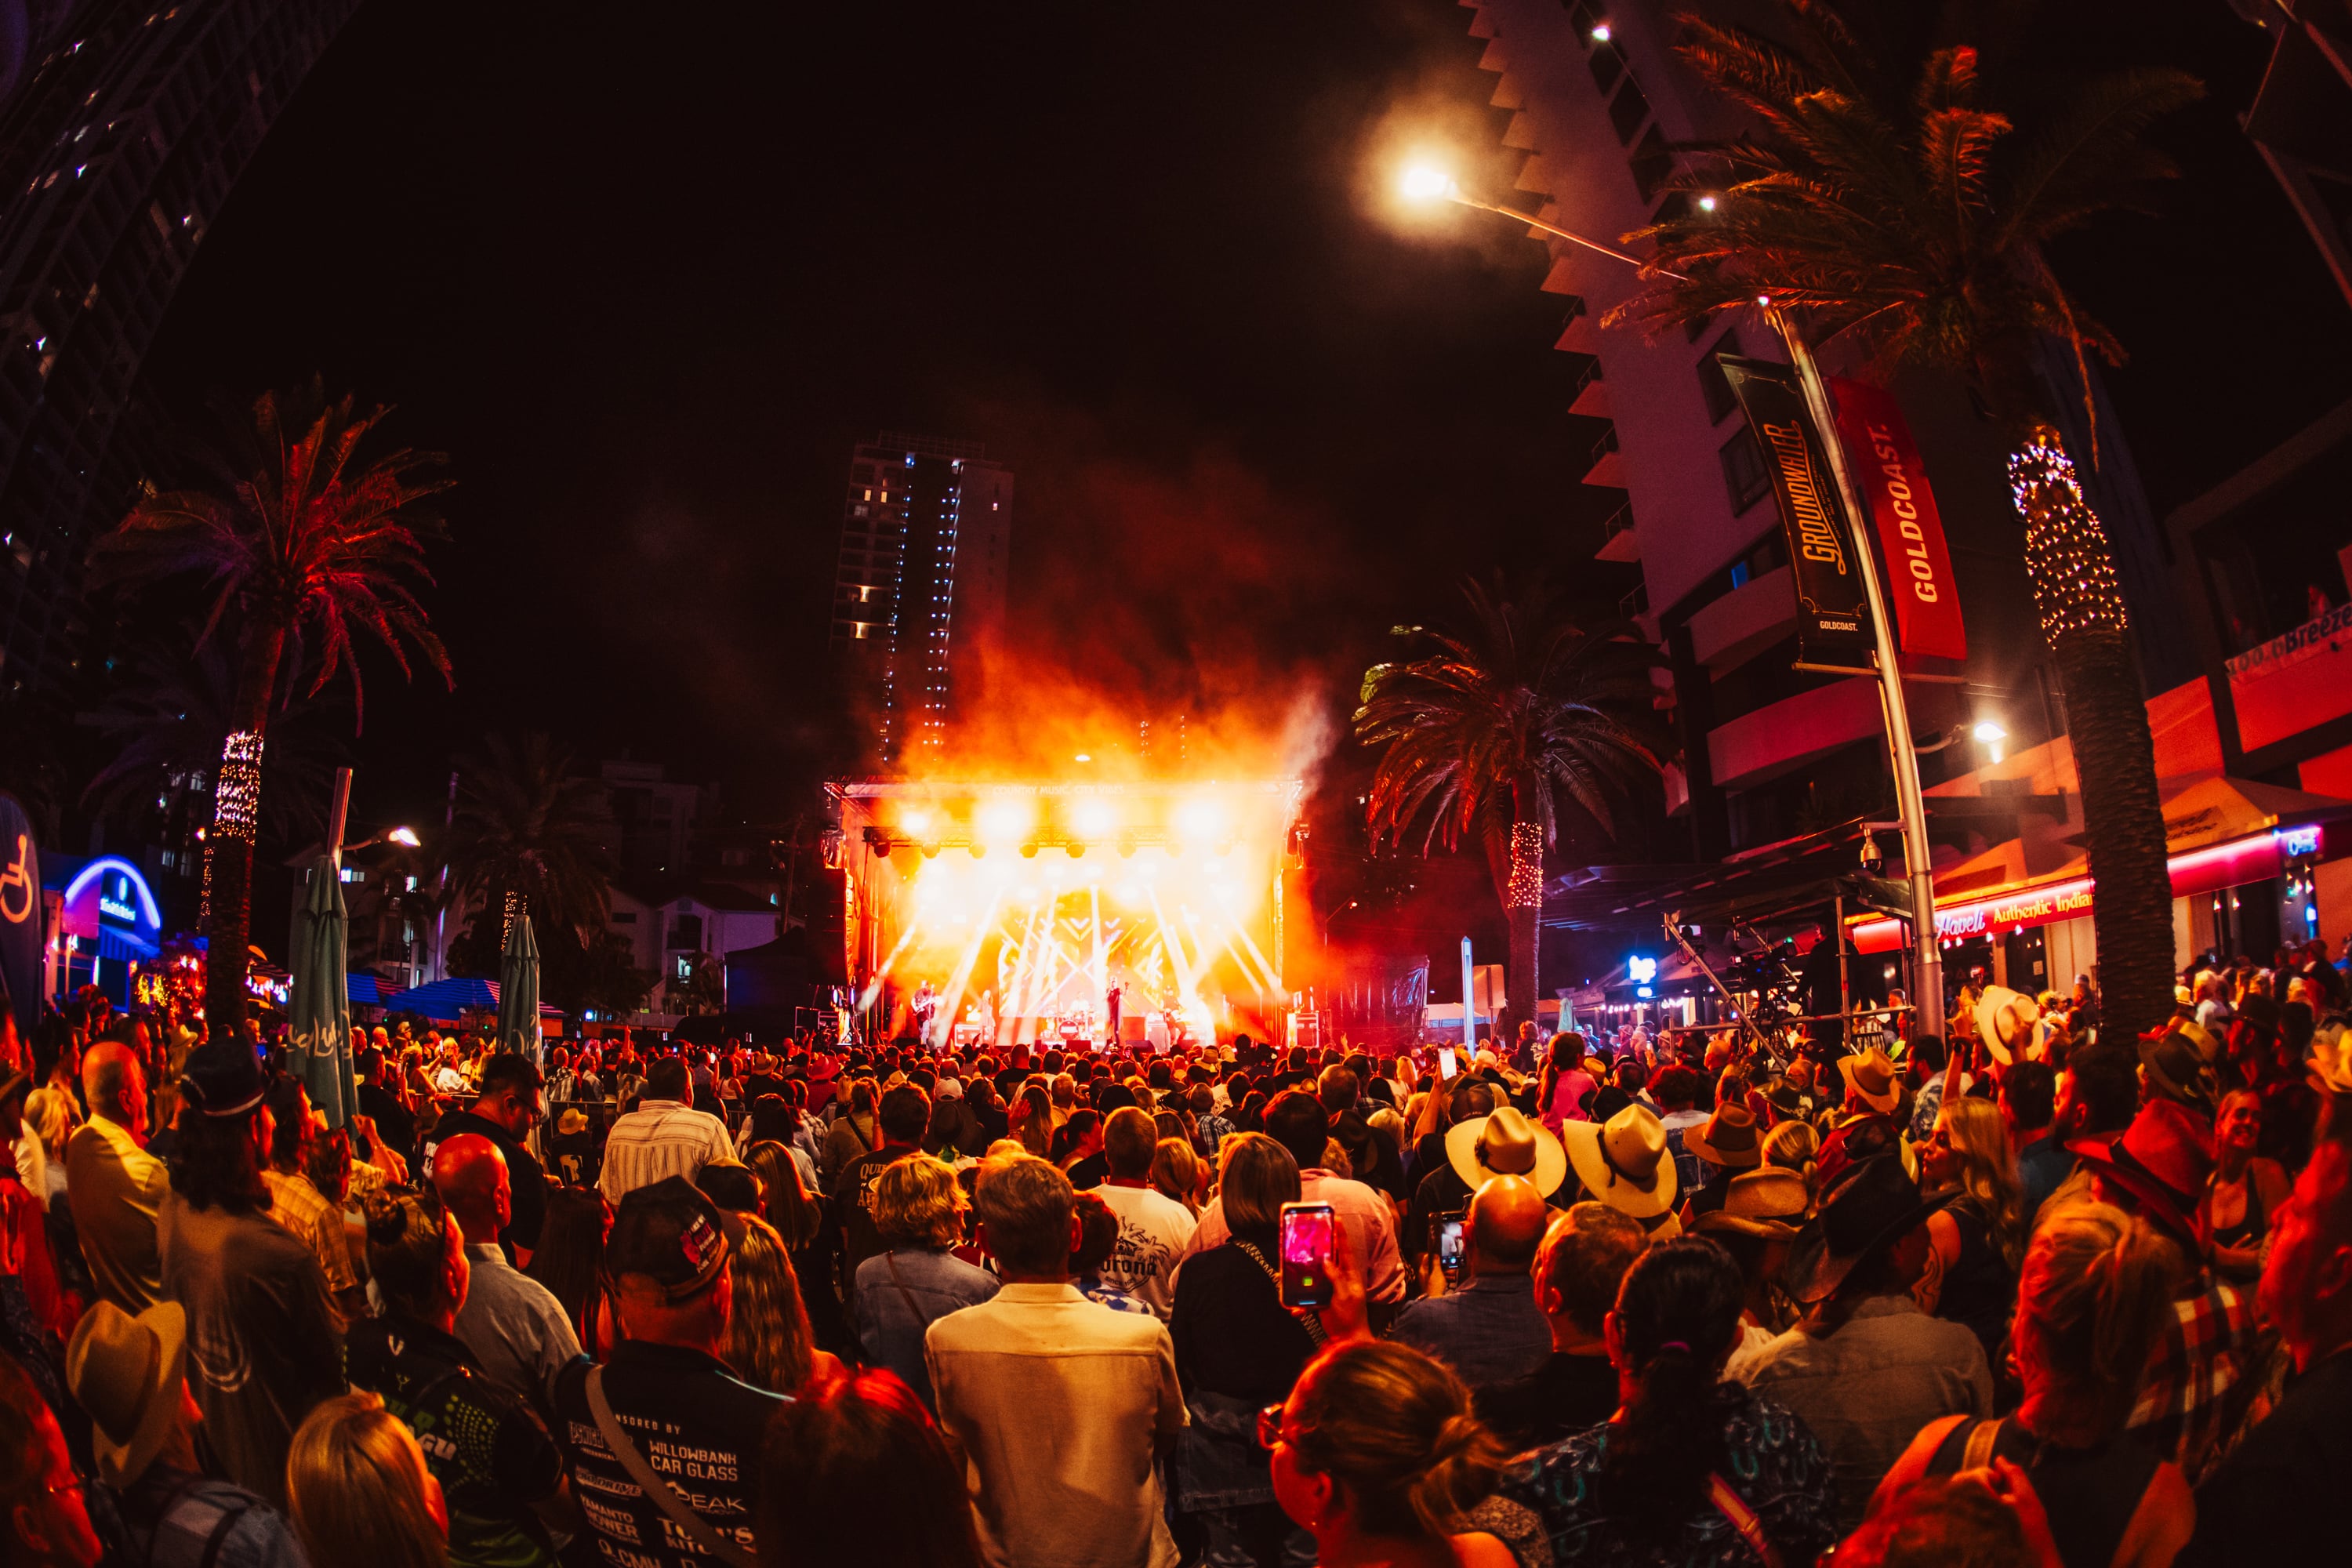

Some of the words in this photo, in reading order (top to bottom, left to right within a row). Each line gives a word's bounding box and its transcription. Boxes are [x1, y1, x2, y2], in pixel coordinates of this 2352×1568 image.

[1763, 420, 1846, 575] GROUNDWATER
[1867, 423, 1938, 603] GOLDCOAST.
[1820, 620, 1858, 632] GOLDCOAST.
[993, 785, 1036, 796] COUNTRY
[1994, 898, 2053, 924] Authentic
[1101, 1256, 1157, 1276] orona
[615, 1414, 658, 1431] NSORED
[666, 1424, 681, 1435] BY
[651, 1455, 682, 1475] CAR
[687, 1462, 739, 1483] GLASS
